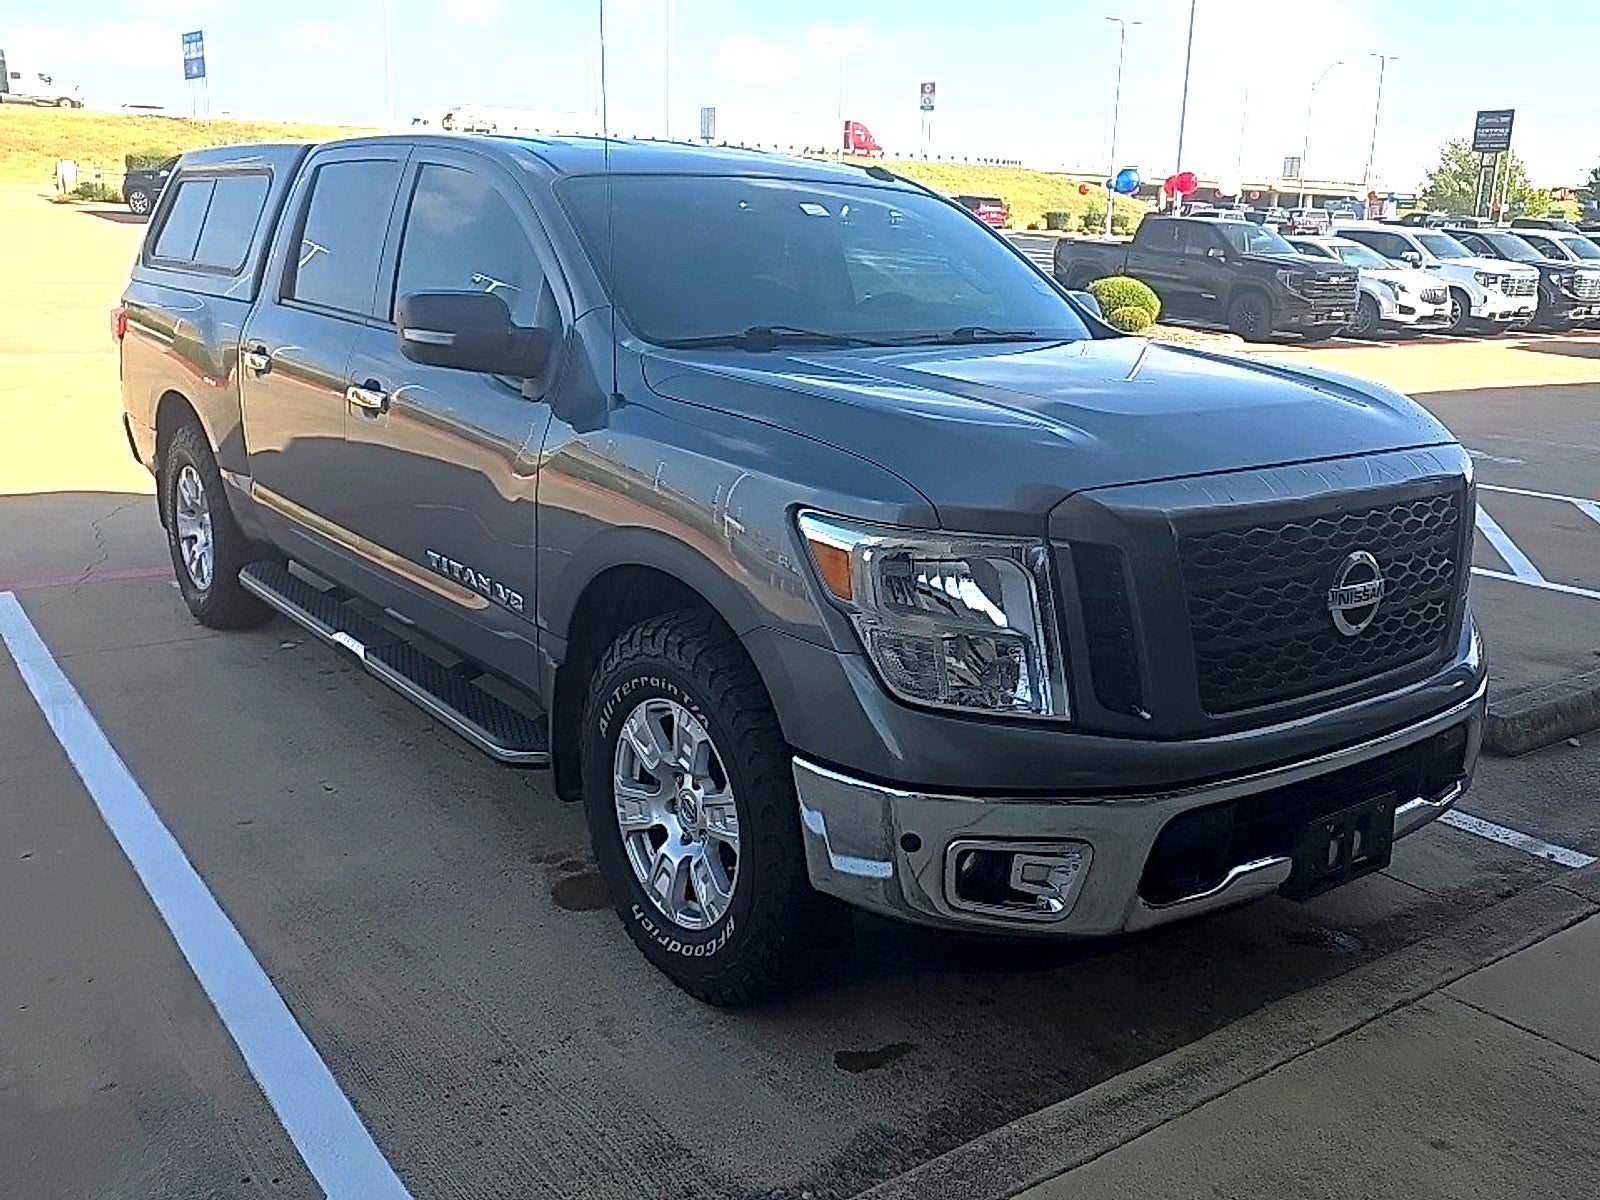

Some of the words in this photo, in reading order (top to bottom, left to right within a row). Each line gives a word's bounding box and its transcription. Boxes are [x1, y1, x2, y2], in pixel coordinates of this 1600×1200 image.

[426, 549, 492, 595] TITAN
[495, 582, 524, 612] V8
[1337, 581, 1384, 606] NISSAN
[681, 690, 710, 730] T/A
[631, 904, 735, 957] BFGoodrich
